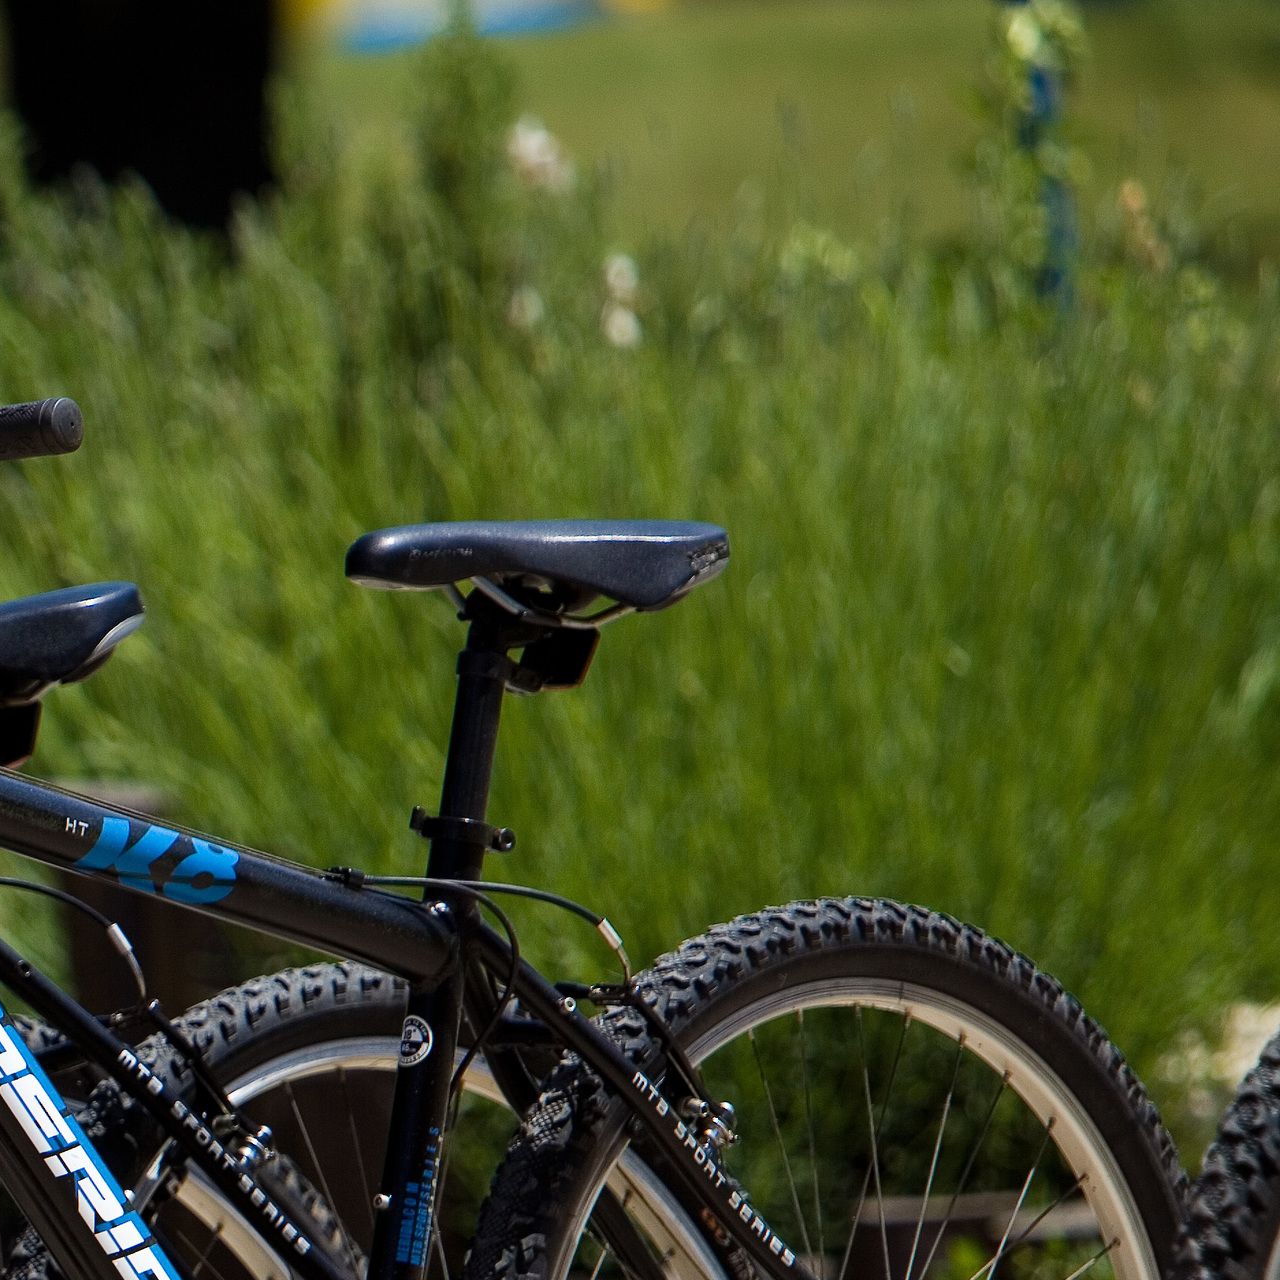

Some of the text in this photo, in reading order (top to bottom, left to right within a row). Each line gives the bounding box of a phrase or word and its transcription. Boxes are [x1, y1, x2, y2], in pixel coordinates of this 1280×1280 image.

[75, 816, 240, 905] K8
[171, 1100, 241, 1170] SPORT
[239, 1173, 311, 1255] SERIES
[632, 1072, 669, 1117] MTB
[674, 1121, 726, 1188] SPORT
[728, 1190, 796, 1266] SERIES
